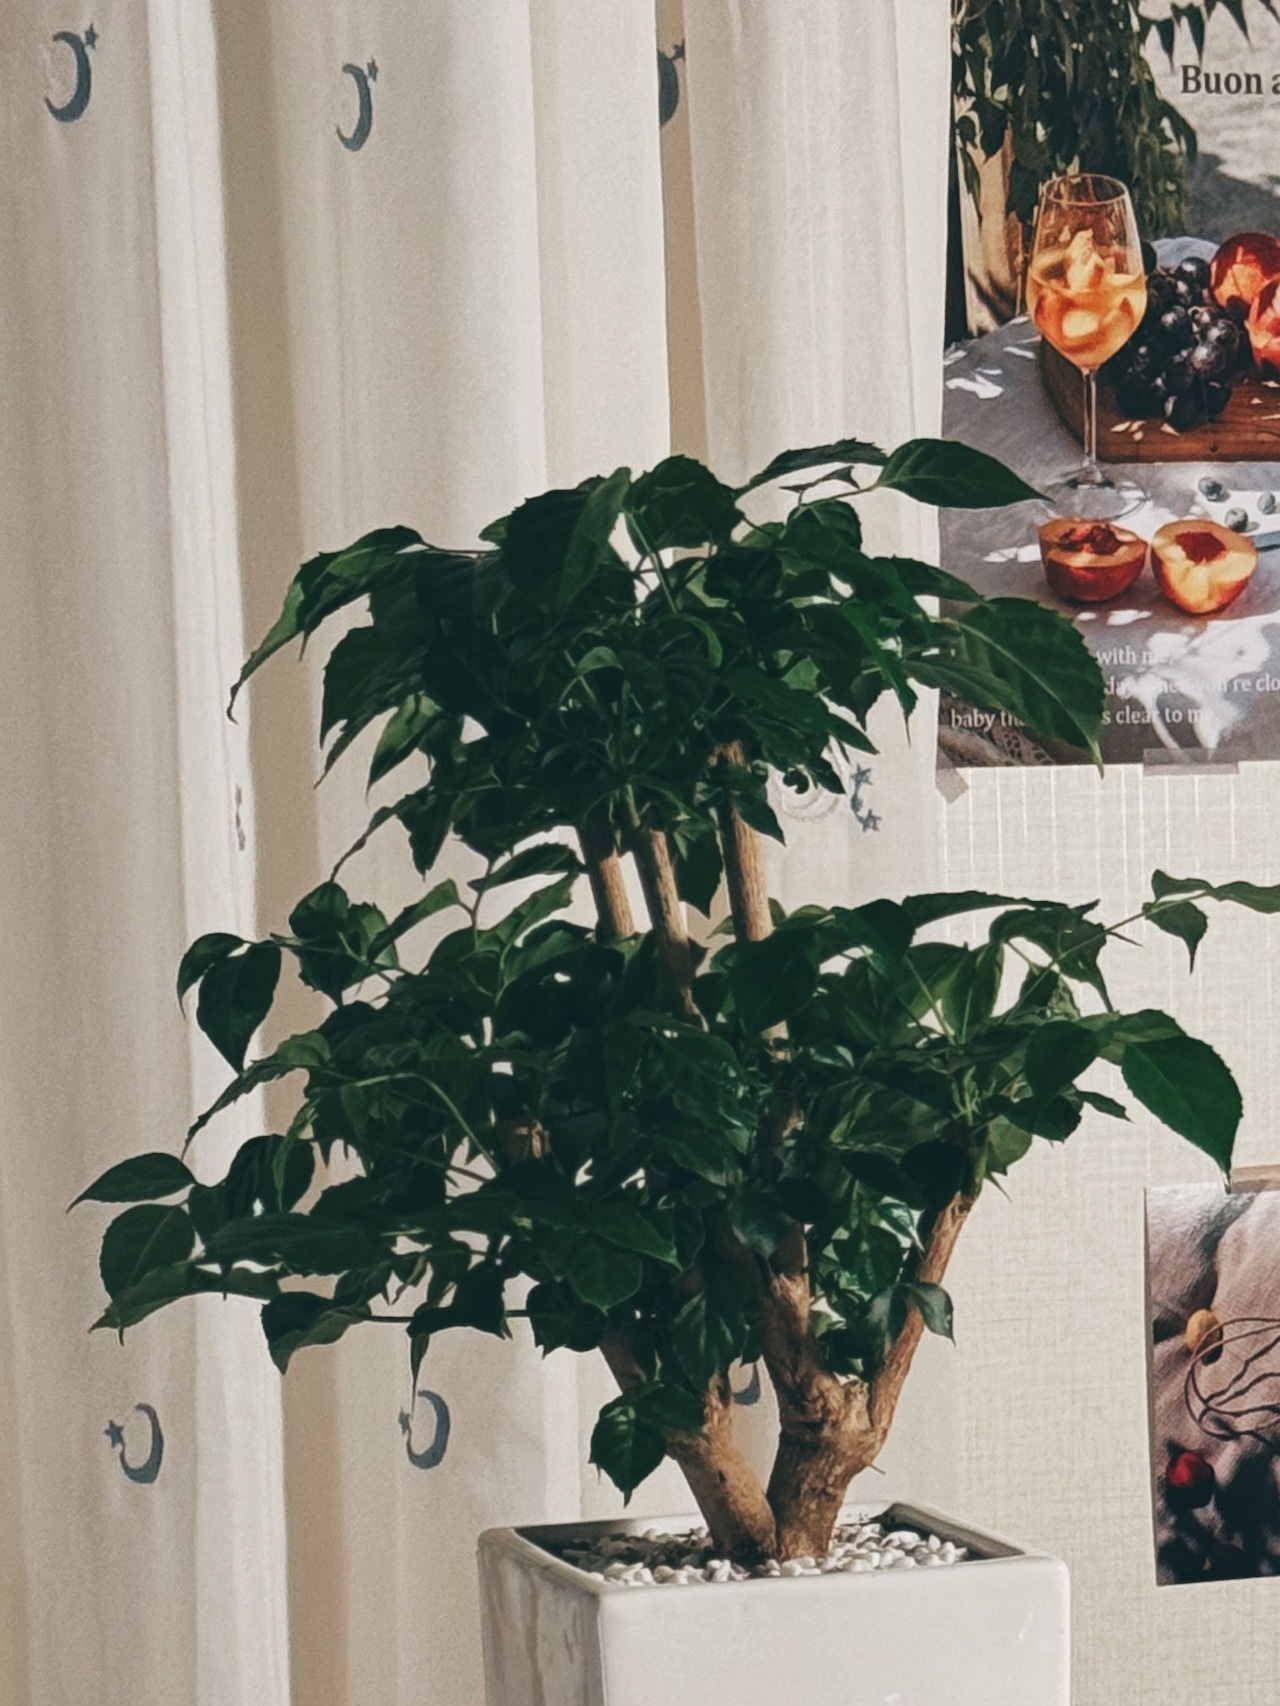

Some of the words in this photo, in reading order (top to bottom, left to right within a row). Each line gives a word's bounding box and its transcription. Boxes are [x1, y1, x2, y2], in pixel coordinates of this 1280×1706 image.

[1180, 64, 1263, 95] Buon
[951, 707, 996, 733] baby
[1115, 705, 1159, 725] clear
[1165, 706, 1183, 724] to
